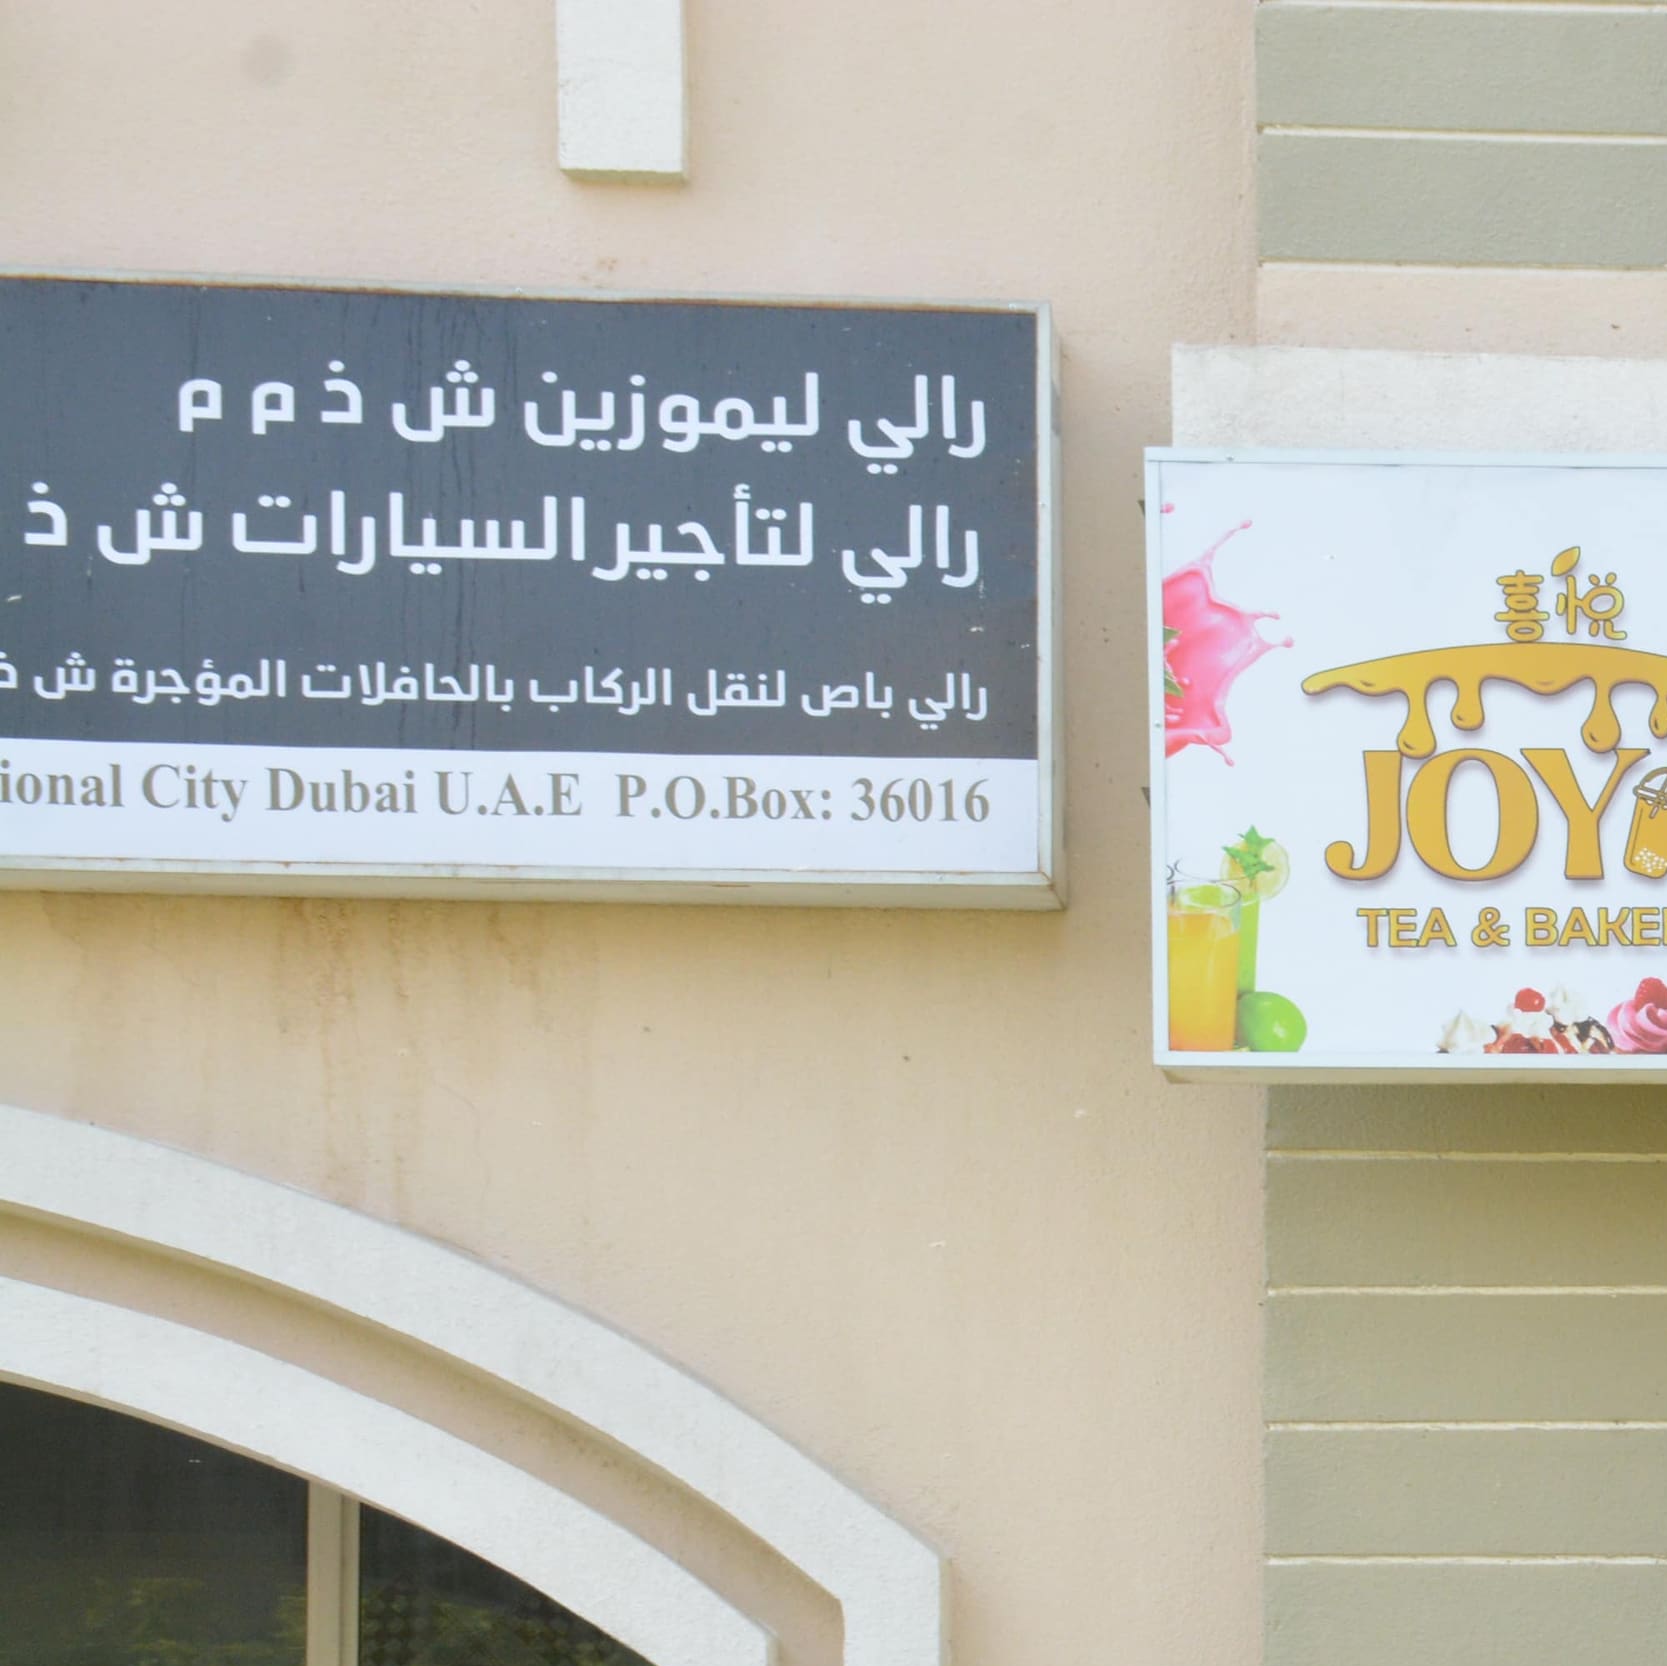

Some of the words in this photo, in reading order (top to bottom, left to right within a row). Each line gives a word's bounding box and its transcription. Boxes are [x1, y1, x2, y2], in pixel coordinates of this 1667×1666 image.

[392, 360, 494, 442] ش
[525, 372, 819, 452] ليموزين
[848, 375, 985, 474] رالي
[98, 483, 202, 565] ش
[842, 505, 978, 604] رالي
[35, 653, 95, 699] ش
[112, 658, 286, 705] المؤجرة
[302, 662, 513, 711] بالحافلات
[530, 665, 671, 715] الركاب
[688, 669, 785, 715] لنقل
[802, 671, 892, 718] باص
[909, 673, 987, 730] رالي
[142, 764, 247, 822] City
[266, 768, 416, 813] Dubai
[435, 772, 581, 817] U.A.E
[850, 778, 989, 822] 36016
[1325, 748, 1650, 882] JOY
[1357, 908, 1455, 948] TEA
[1472, 908, 1509, 948] &
